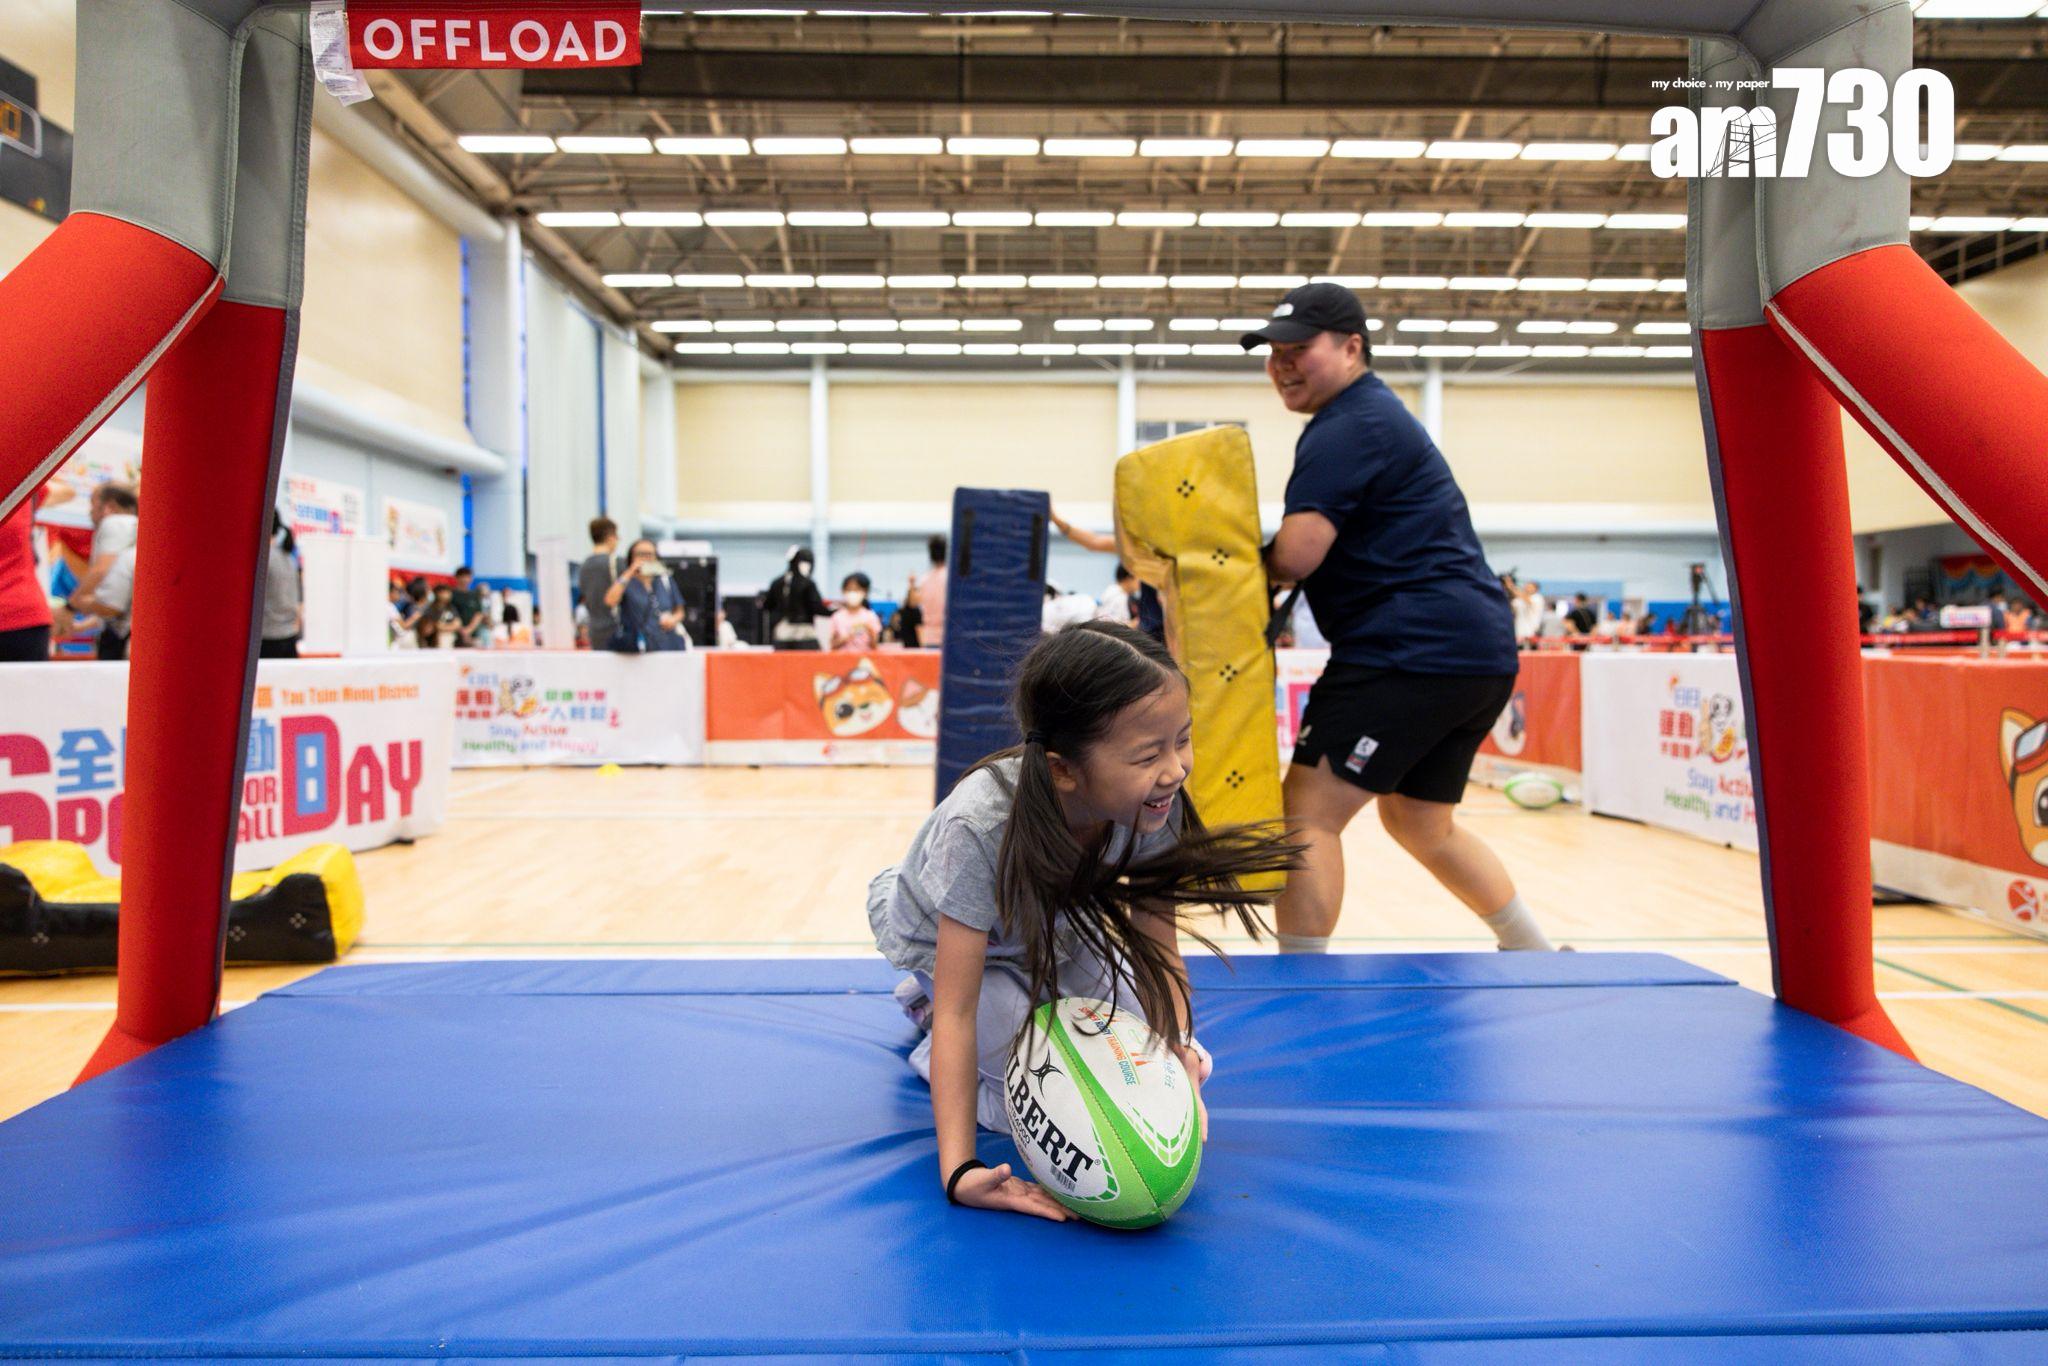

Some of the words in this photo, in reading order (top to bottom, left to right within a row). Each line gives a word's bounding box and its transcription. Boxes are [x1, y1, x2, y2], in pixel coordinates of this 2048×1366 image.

[363, 18, 627, 62] OFFLOAD
[245, 776, 277, 806] OR
[281, 714, 422, 837] DAY
[1118, 1060, 1137, 1086] COURSE
